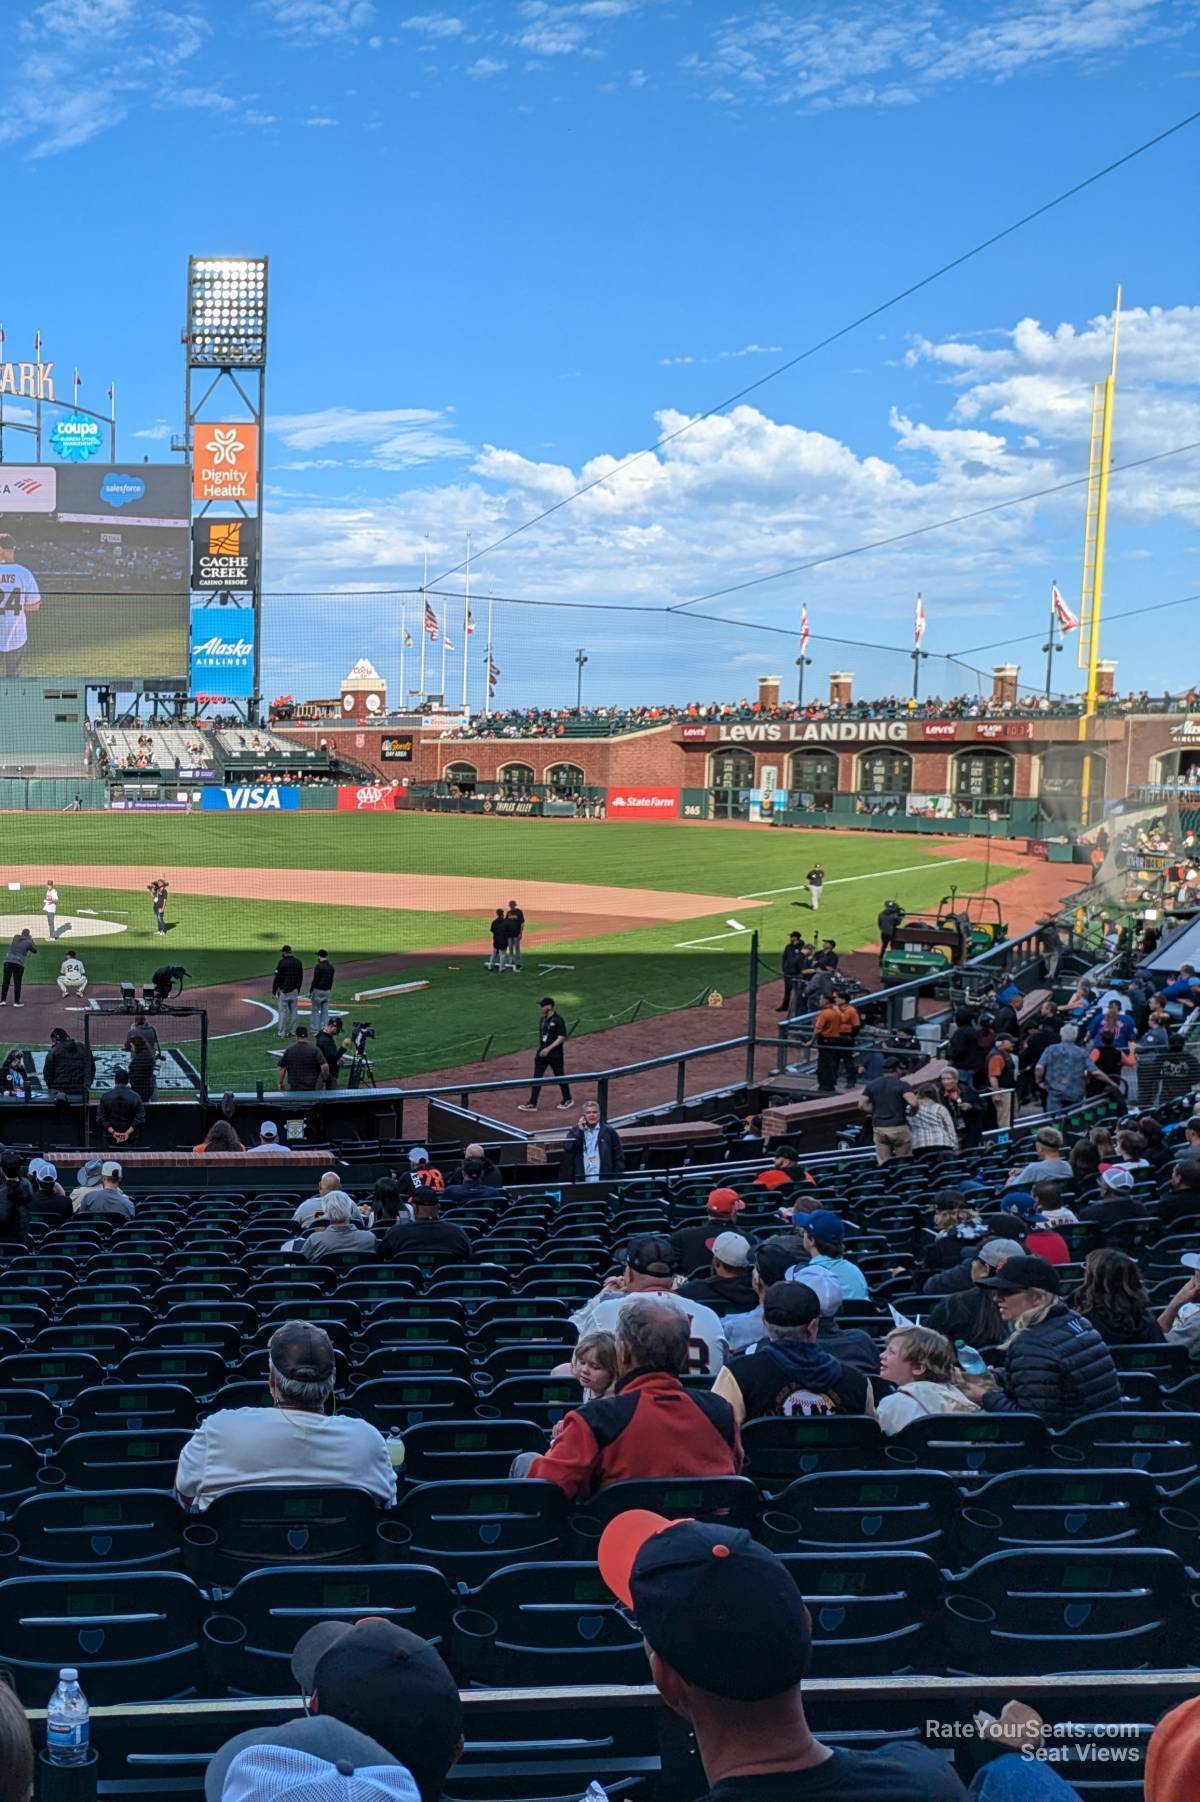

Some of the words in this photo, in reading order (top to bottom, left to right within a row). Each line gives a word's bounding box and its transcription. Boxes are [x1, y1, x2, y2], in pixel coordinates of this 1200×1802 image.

[57, 423, 98, 437] coupa
[202, 469, 247, 484] Dignity
[106, 484, 141, 494] salesforce
[203, 485, 245, 497] Health
[200, 557, 248, 567] CACHE
[201, 568, 247, 578] CREEK
[192, 637, 253, 657] Alaska
[789, 722, 908, 741] LANDING
[221, 788, 281, 809] VISA
[496, 802, 514, 812] TRIPLES
[516, 803, 532, 813] ALLEY
[684, 805, 700, 815] 365
[66, 964, 80, 973] 24
